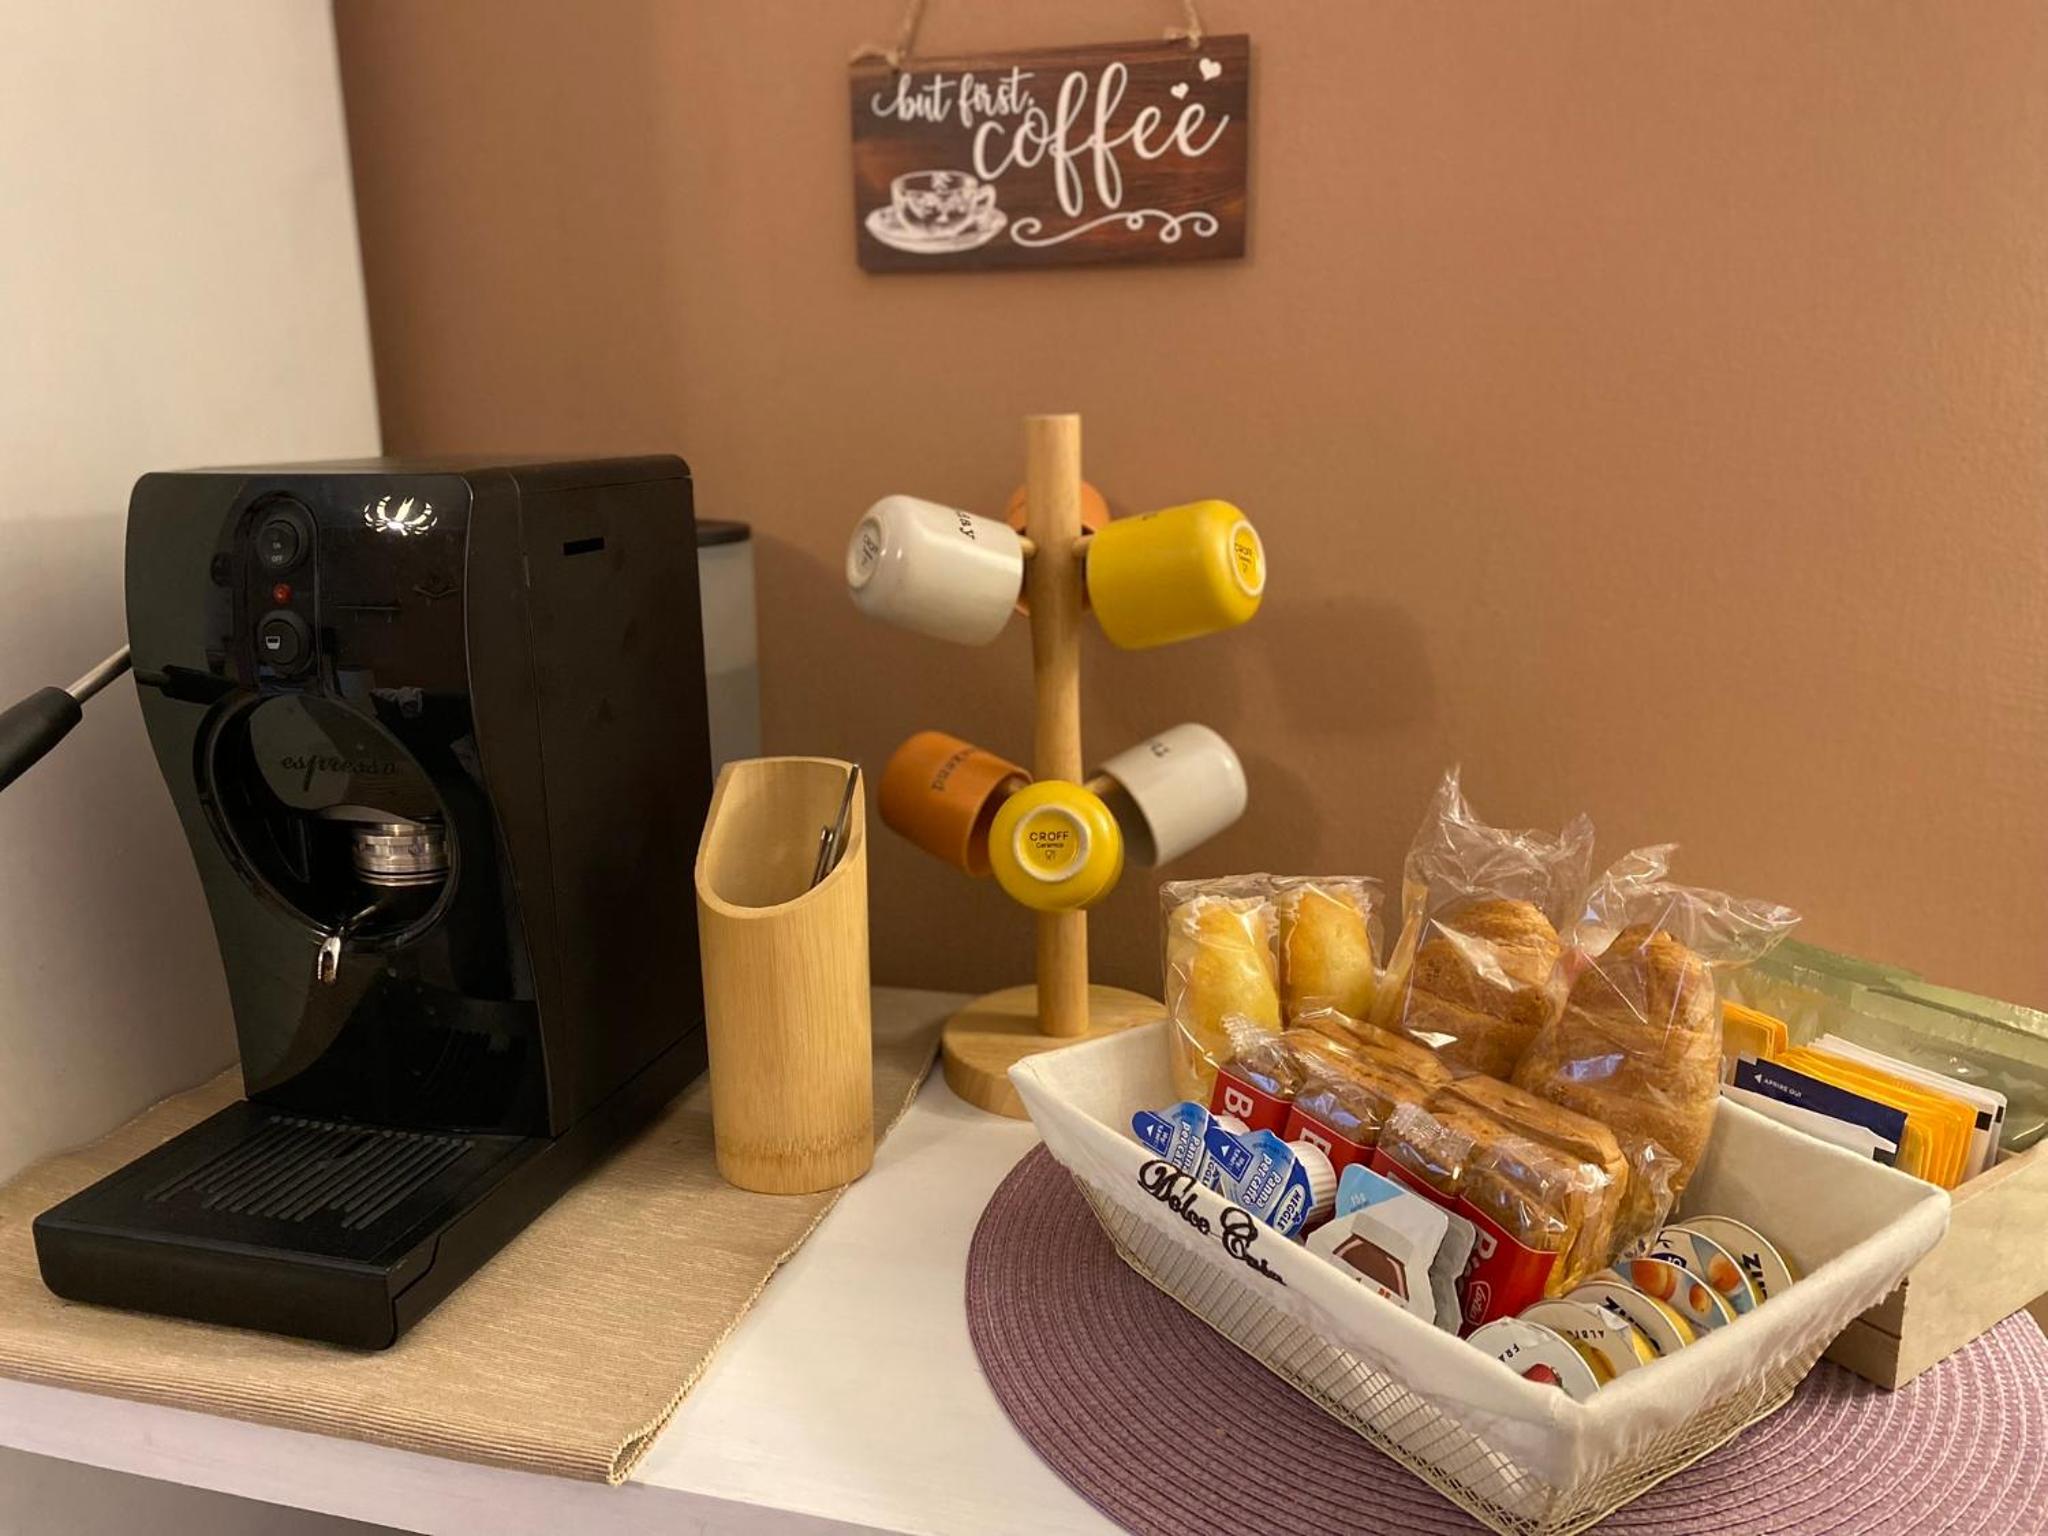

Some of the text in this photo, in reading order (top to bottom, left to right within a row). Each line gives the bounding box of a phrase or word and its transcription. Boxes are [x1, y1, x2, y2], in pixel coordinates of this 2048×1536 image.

[871, 73, 957, 122] but
[973, 62, 1230, 217] coffee
[1029, 831, 1069, 842] CROFF
[1257, 1171, 1283, 1209] Panna
[1279, 1190, 1303, 1230] MEGGLE
